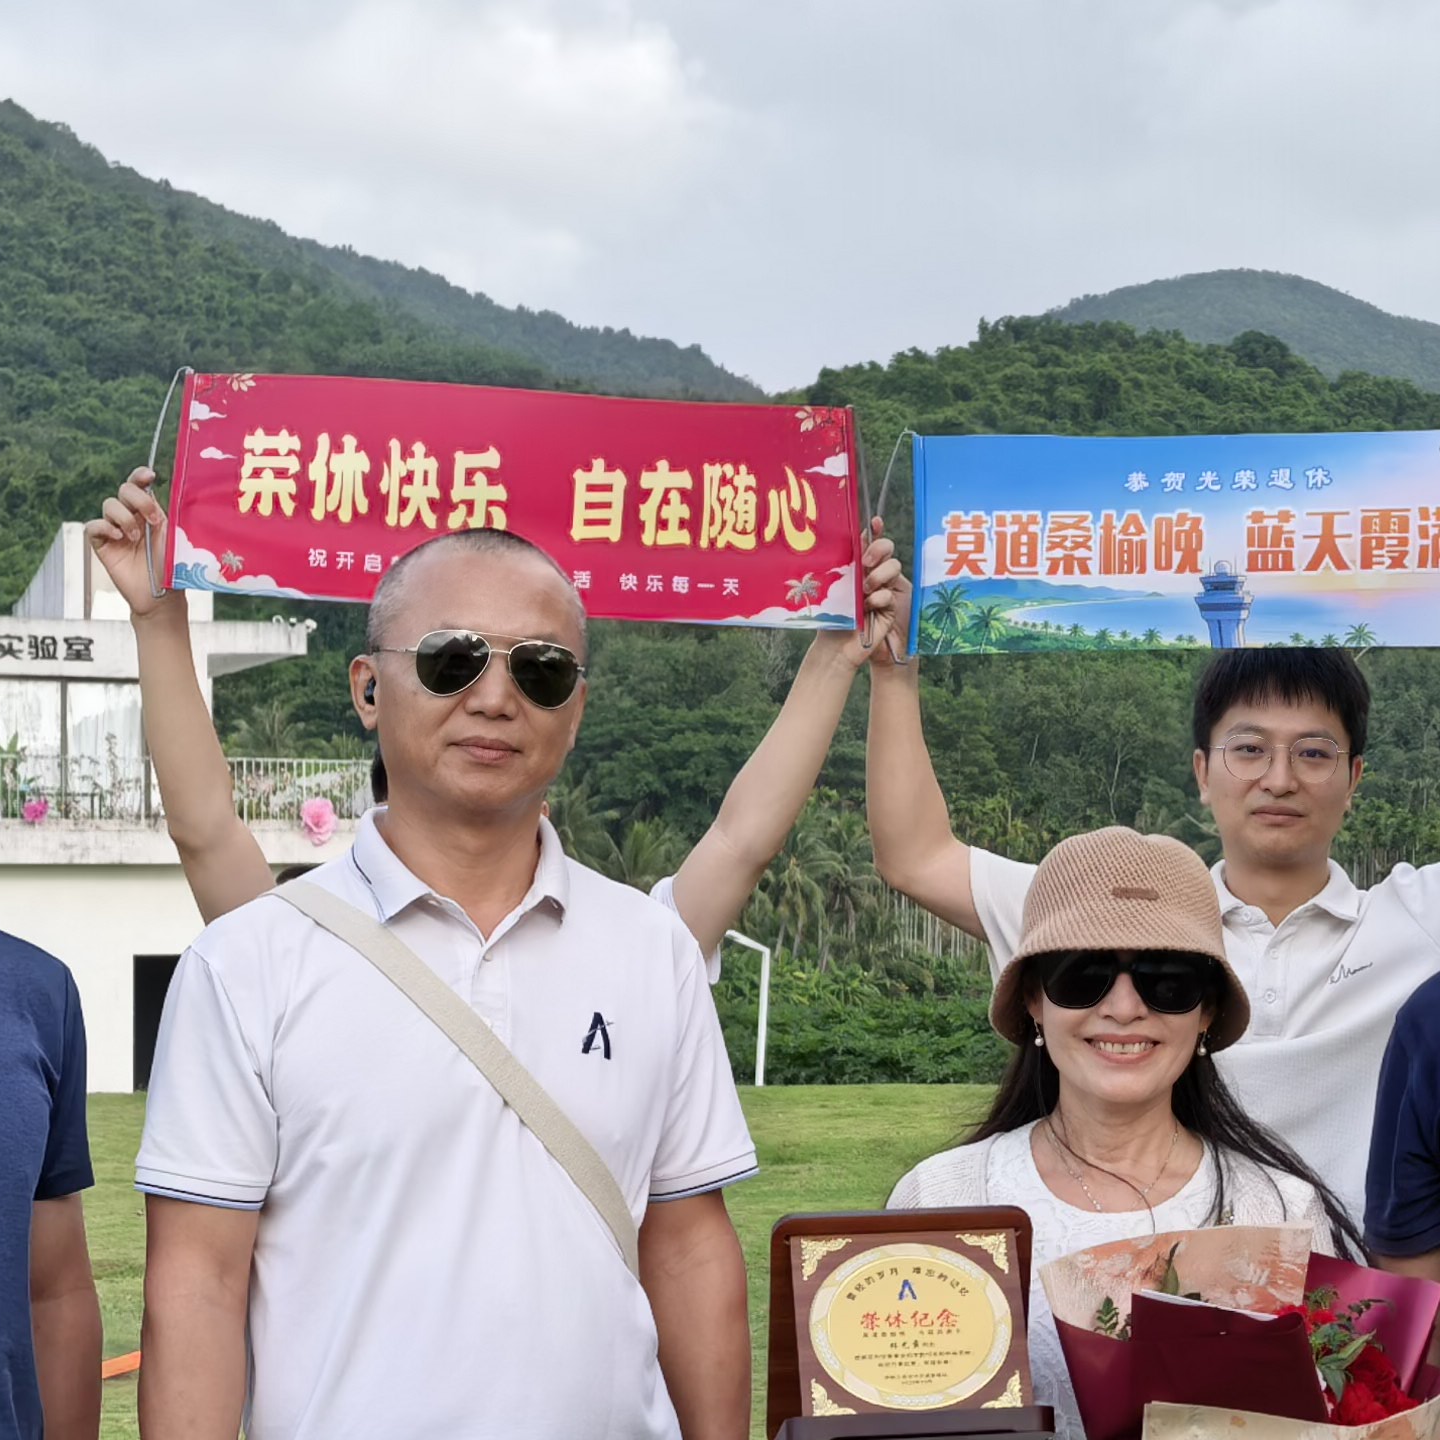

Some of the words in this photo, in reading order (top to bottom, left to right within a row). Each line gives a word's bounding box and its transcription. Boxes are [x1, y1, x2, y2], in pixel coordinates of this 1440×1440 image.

[237, 427, 508, 532] 荣休快乐
[570, 458, 817, 551] 自在随心
[1124, 466, 1333, 492] 恭贺光荣退休
[942, 510, 1204, 576] 莫道桑榆晚
[308, 548, 400, 573] 祝开启
[619, 573, 739, 596] 快乐每一天
